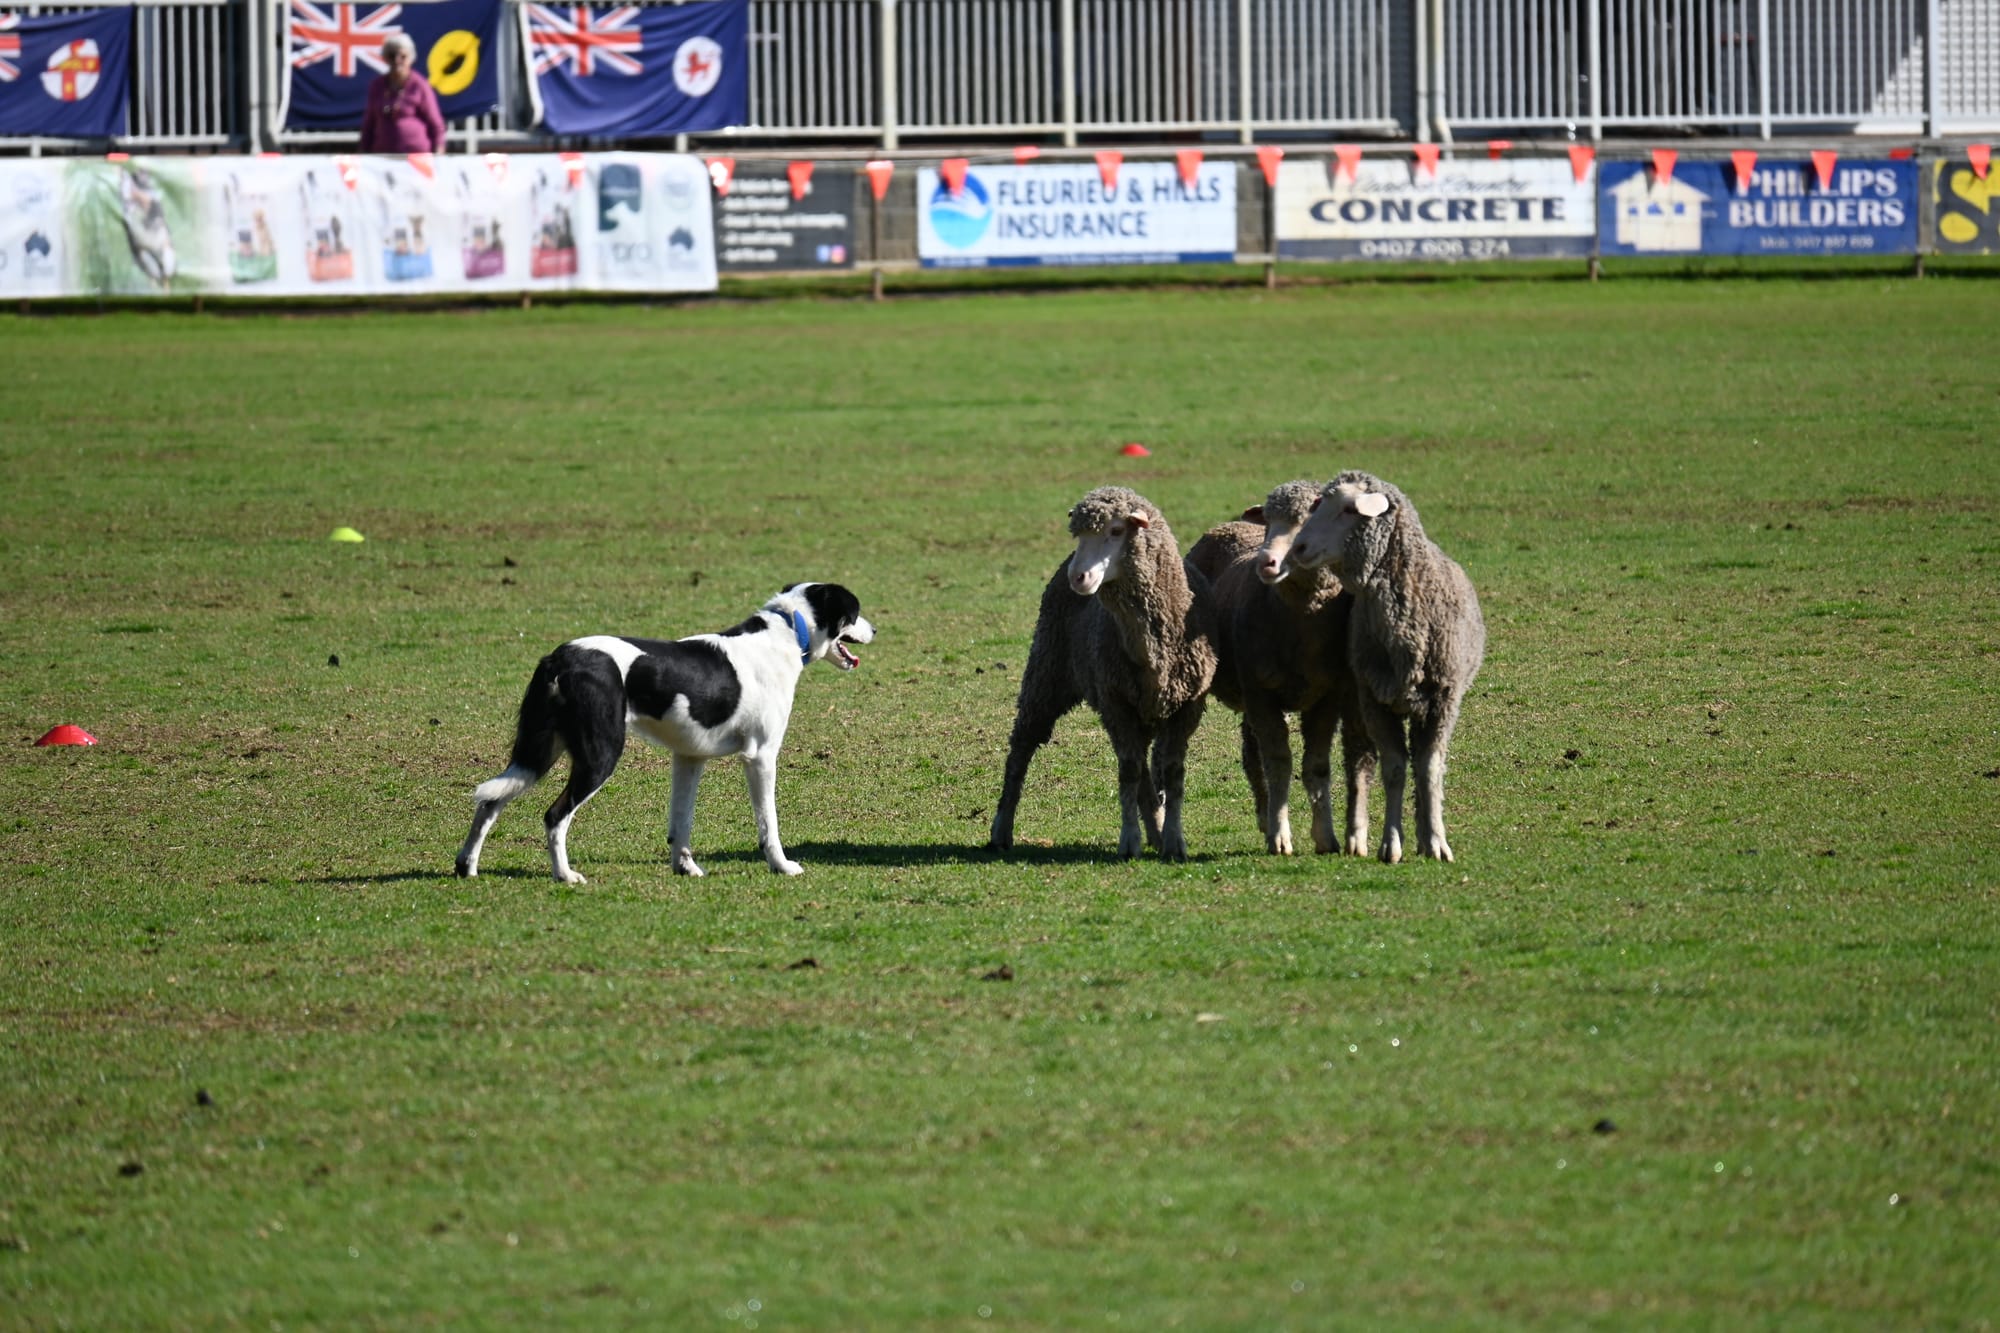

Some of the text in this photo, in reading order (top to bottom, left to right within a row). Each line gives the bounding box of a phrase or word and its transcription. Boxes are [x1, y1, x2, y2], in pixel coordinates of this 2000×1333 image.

[998, 177, 1220, 205] FLEURIEU & HILLS
[1309, 197, 1566, 223] CONCRETE
[1729, 198, 1905, 228] BUILDERS
[998, 210, 1149, 239] INSURANCE
